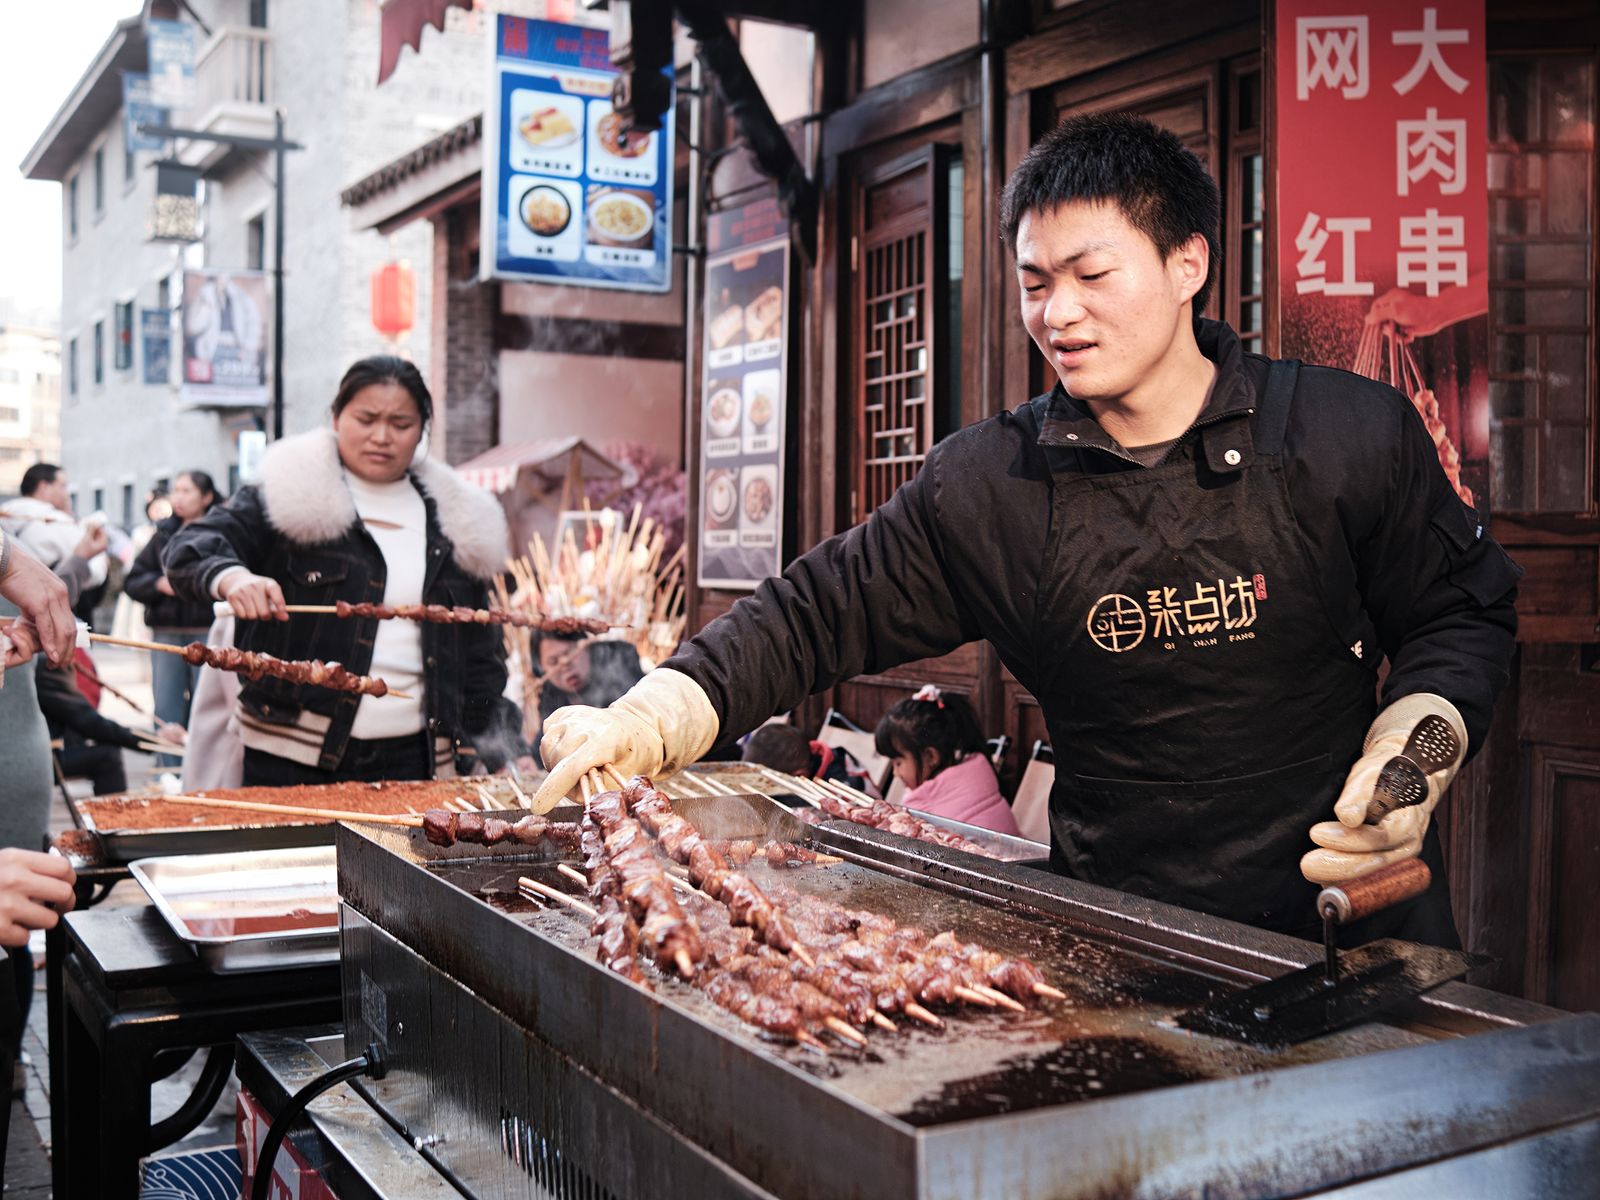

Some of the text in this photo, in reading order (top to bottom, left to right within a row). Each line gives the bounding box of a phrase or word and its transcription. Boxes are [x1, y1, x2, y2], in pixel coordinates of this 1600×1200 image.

[1295, 15, 1375, 297] 网红
[1392, 7, 1471, 298] 大肉串
[1146, 575, 1258, 639] 柒点坊
[1163, 642, 1176, 650] QI
[1228, 631, 1256, 642] FANG
